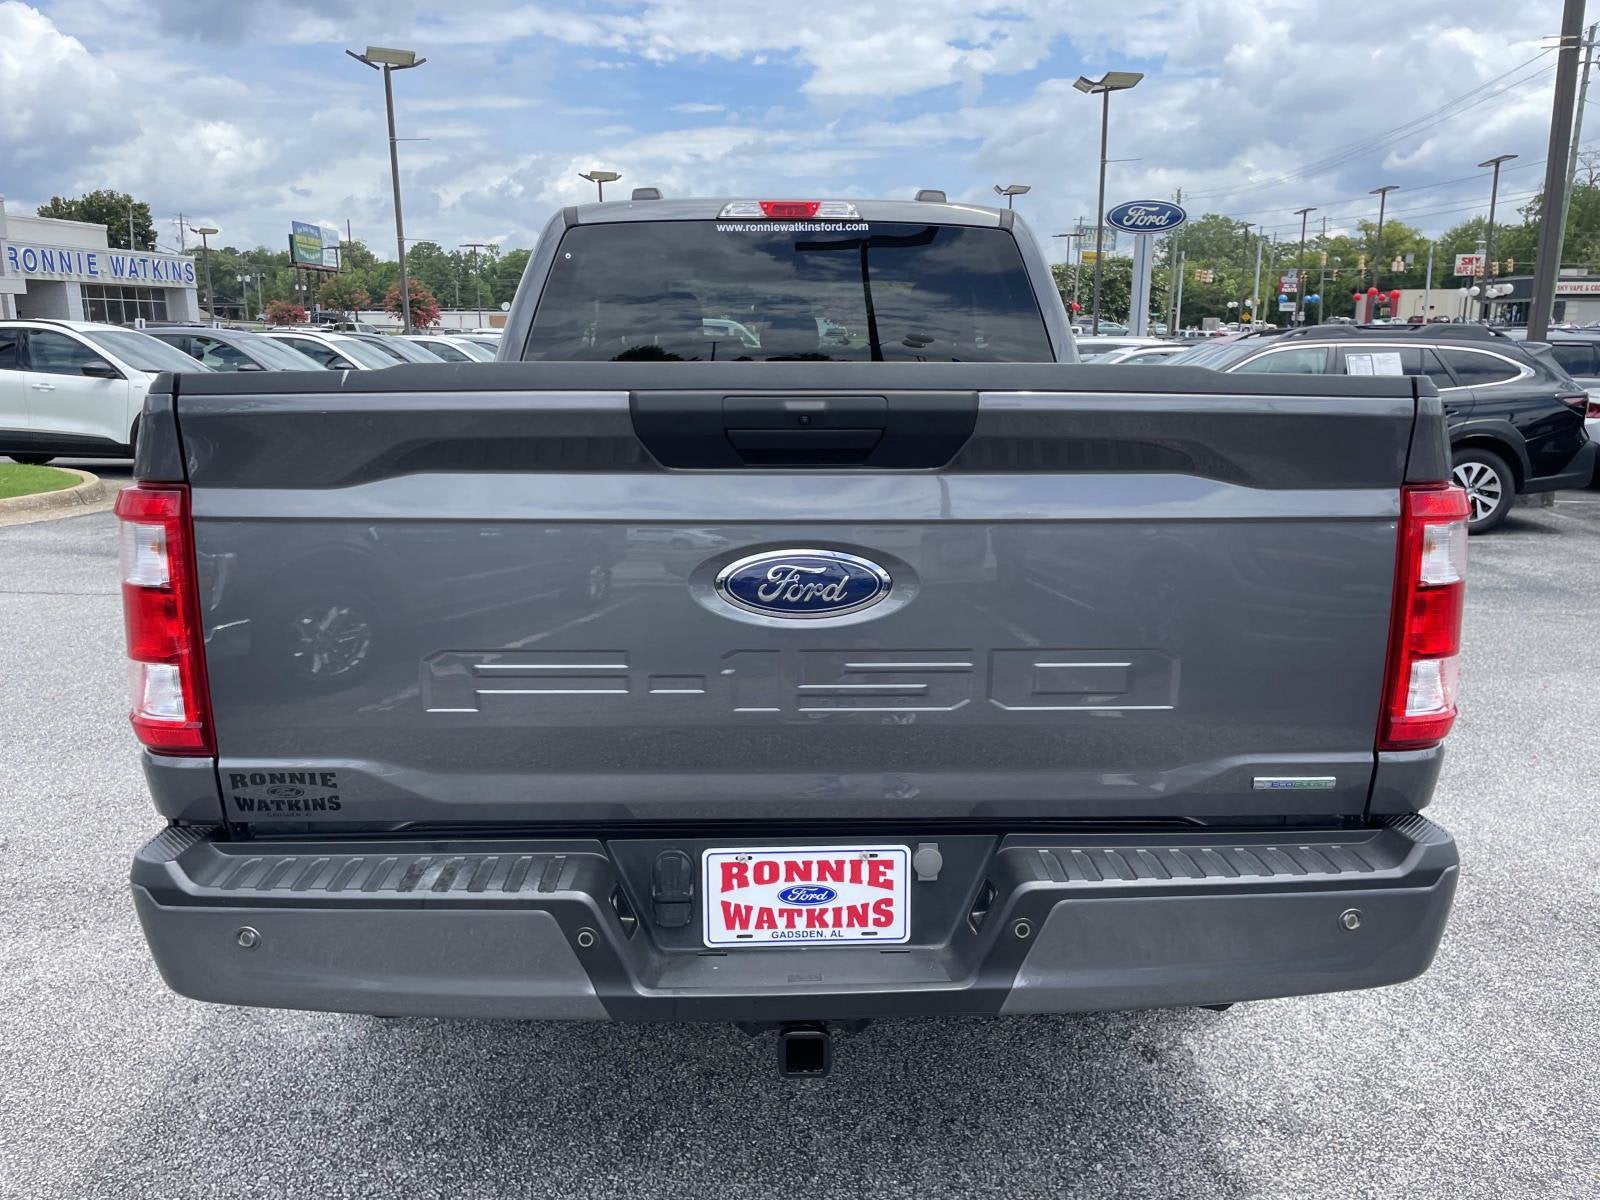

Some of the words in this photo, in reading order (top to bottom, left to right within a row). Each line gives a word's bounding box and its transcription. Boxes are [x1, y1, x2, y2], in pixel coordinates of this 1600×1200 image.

[1123, 205, 1171, 226] Ford
[716, 222, 869, 232] www.ronniewatkinsford.com
[8, 246, 99, 276] RONNIE
[109, 254, 195, 283] WATKINS
[1461, 256, 1481, 265] SKY
[757, 564, 850, 602] Ford
[229, 772, 338, 790] RONNIE
[234, 795, 342, 812] WATKINS
[720, 859, 895, 893] RONNIE
[787, 887, 829, 901] Ford
[720, 897, 895, 931] WATKINS
[771, 930, 827, 939] GADSDEN,
[830, 930, 844, 938] AL
